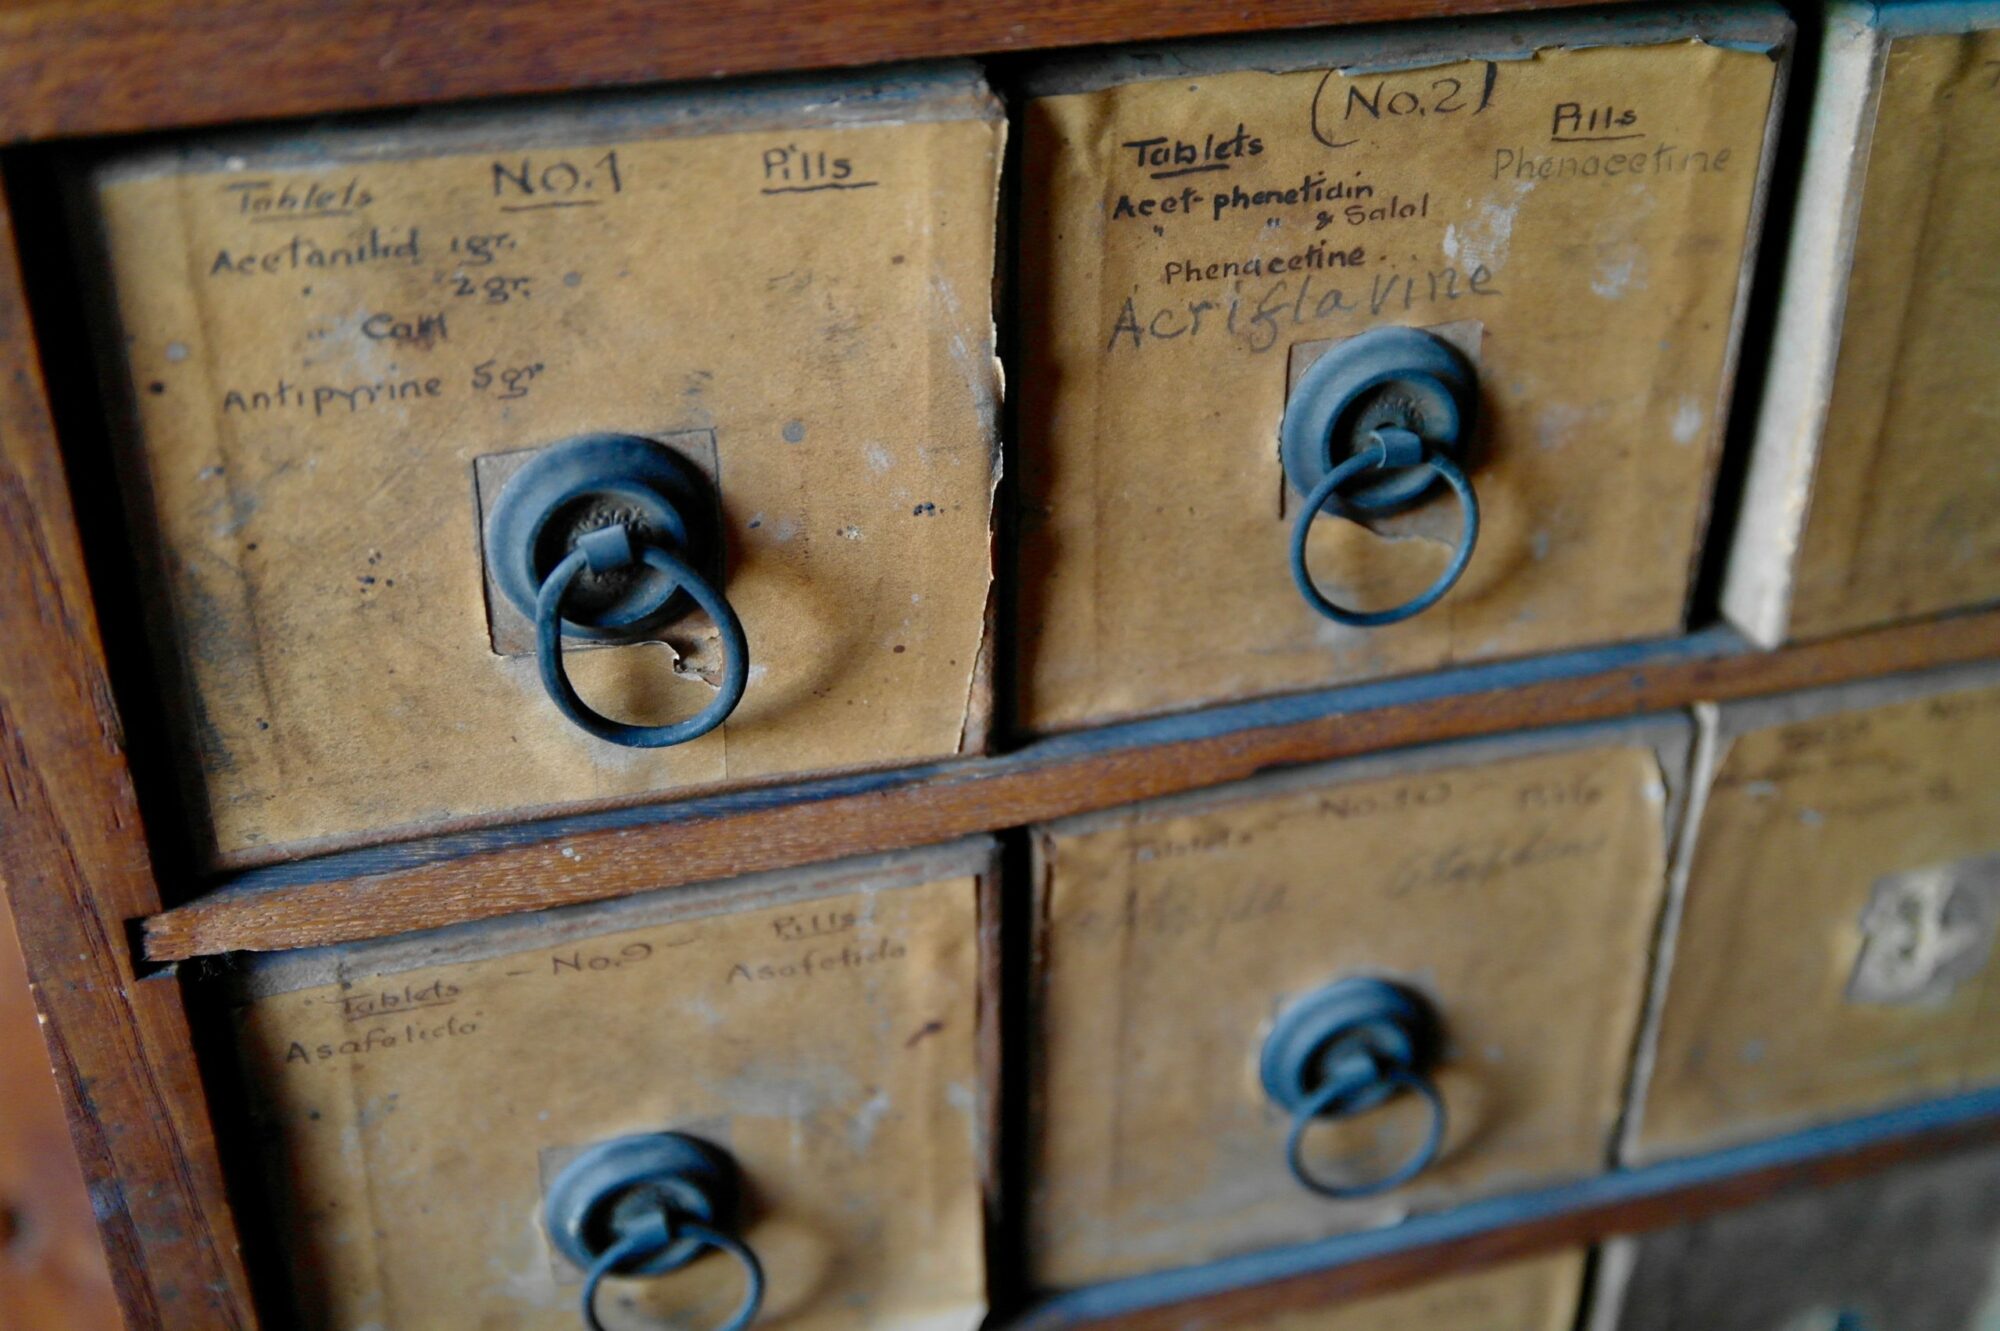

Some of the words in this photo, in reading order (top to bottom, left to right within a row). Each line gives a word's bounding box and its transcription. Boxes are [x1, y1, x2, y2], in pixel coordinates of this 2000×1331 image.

[763, 144, 853, 180] Pills
[1122, 123, 1265, 166] Tablets
[1165, 239, 1366, 285] Phenacetine
